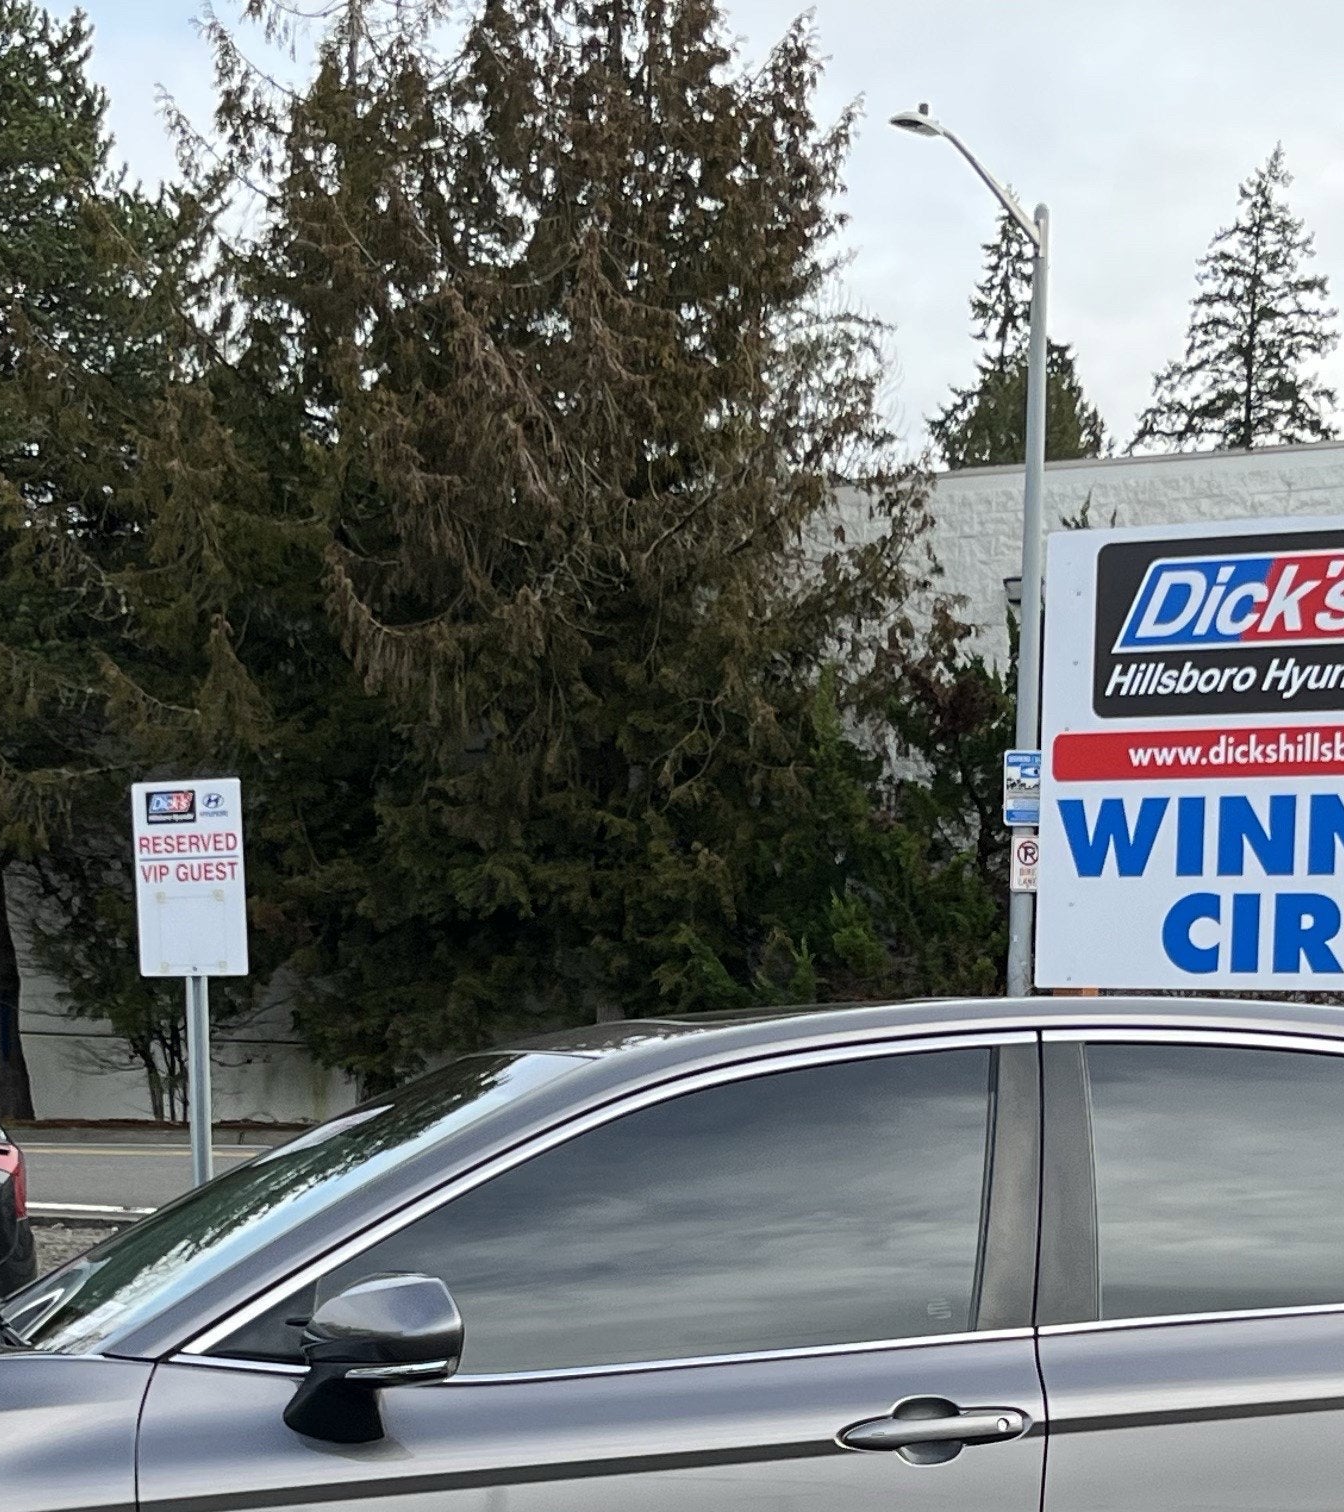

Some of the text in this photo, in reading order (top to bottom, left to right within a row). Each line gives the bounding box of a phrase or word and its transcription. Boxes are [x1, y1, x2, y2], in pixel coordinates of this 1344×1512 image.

[1104, 660, 1258, 697] Hillsboro
[139, 831, 238, 855] RESERVED
[141, 861, 239, 884] VIP GUEST
